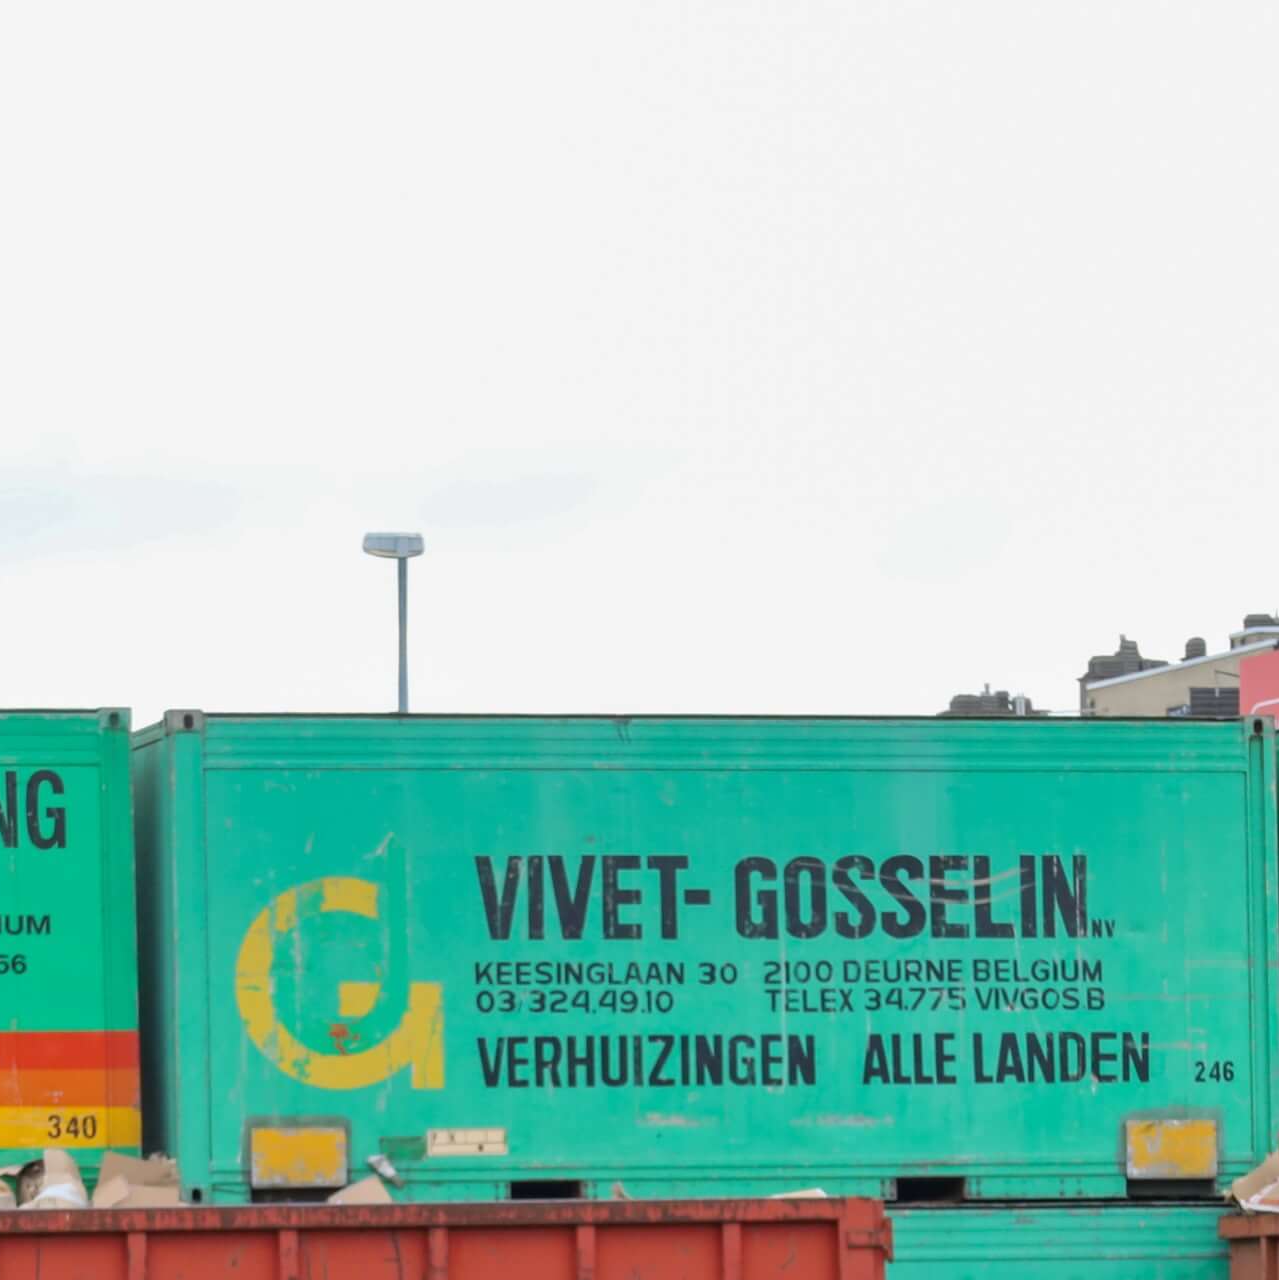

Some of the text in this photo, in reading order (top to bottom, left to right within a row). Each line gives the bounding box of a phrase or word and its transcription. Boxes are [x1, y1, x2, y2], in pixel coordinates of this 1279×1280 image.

[475, 856, 710, 939] VIVET-
[735, 855, 1086, 939] GOSSELIN
[475, 959, 1102, 985] KEESINGLAAN 30 2100 DEURNE BELGIUM
[765, 989, 854, 1013] TELEX
[865, 987, 967, 1011] 34.775
[477, 1032, 1150, 1088] VERHUIZINGEN ALLE LANDEN
[1195, 1061, 1234, 1083] 246
[47, 1115, 97, 1139] 340
